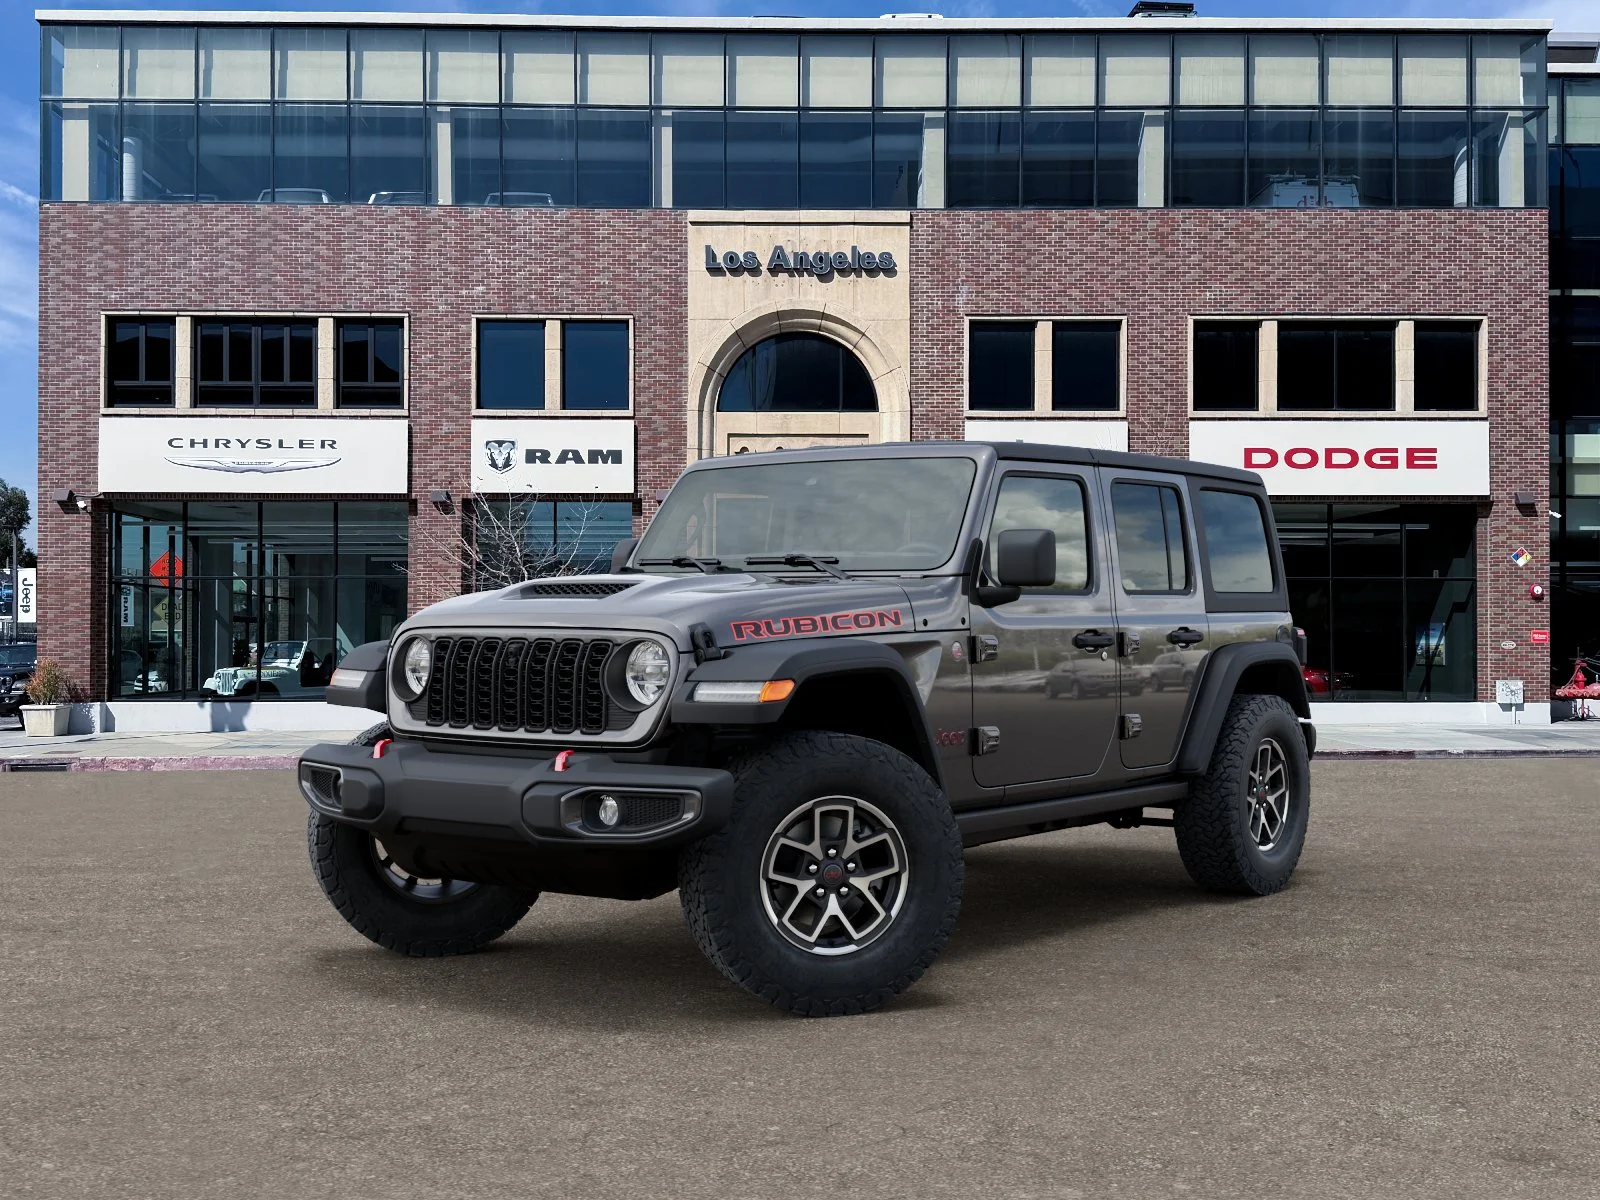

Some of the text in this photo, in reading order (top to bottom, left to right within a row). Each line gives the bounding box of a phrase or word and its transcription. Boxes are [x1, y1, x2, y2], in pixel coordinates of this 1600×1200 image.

[705, 245, 896, 275] Los Angeles
[167, 437, 338, 450] CHRYSLER
[525, 448, 623, 465] RAM
[1243, 447, 1438, 470] DODGE
[20, 577, 34, 614] Jeep
[730, 609, 903, 641] RUBICON
